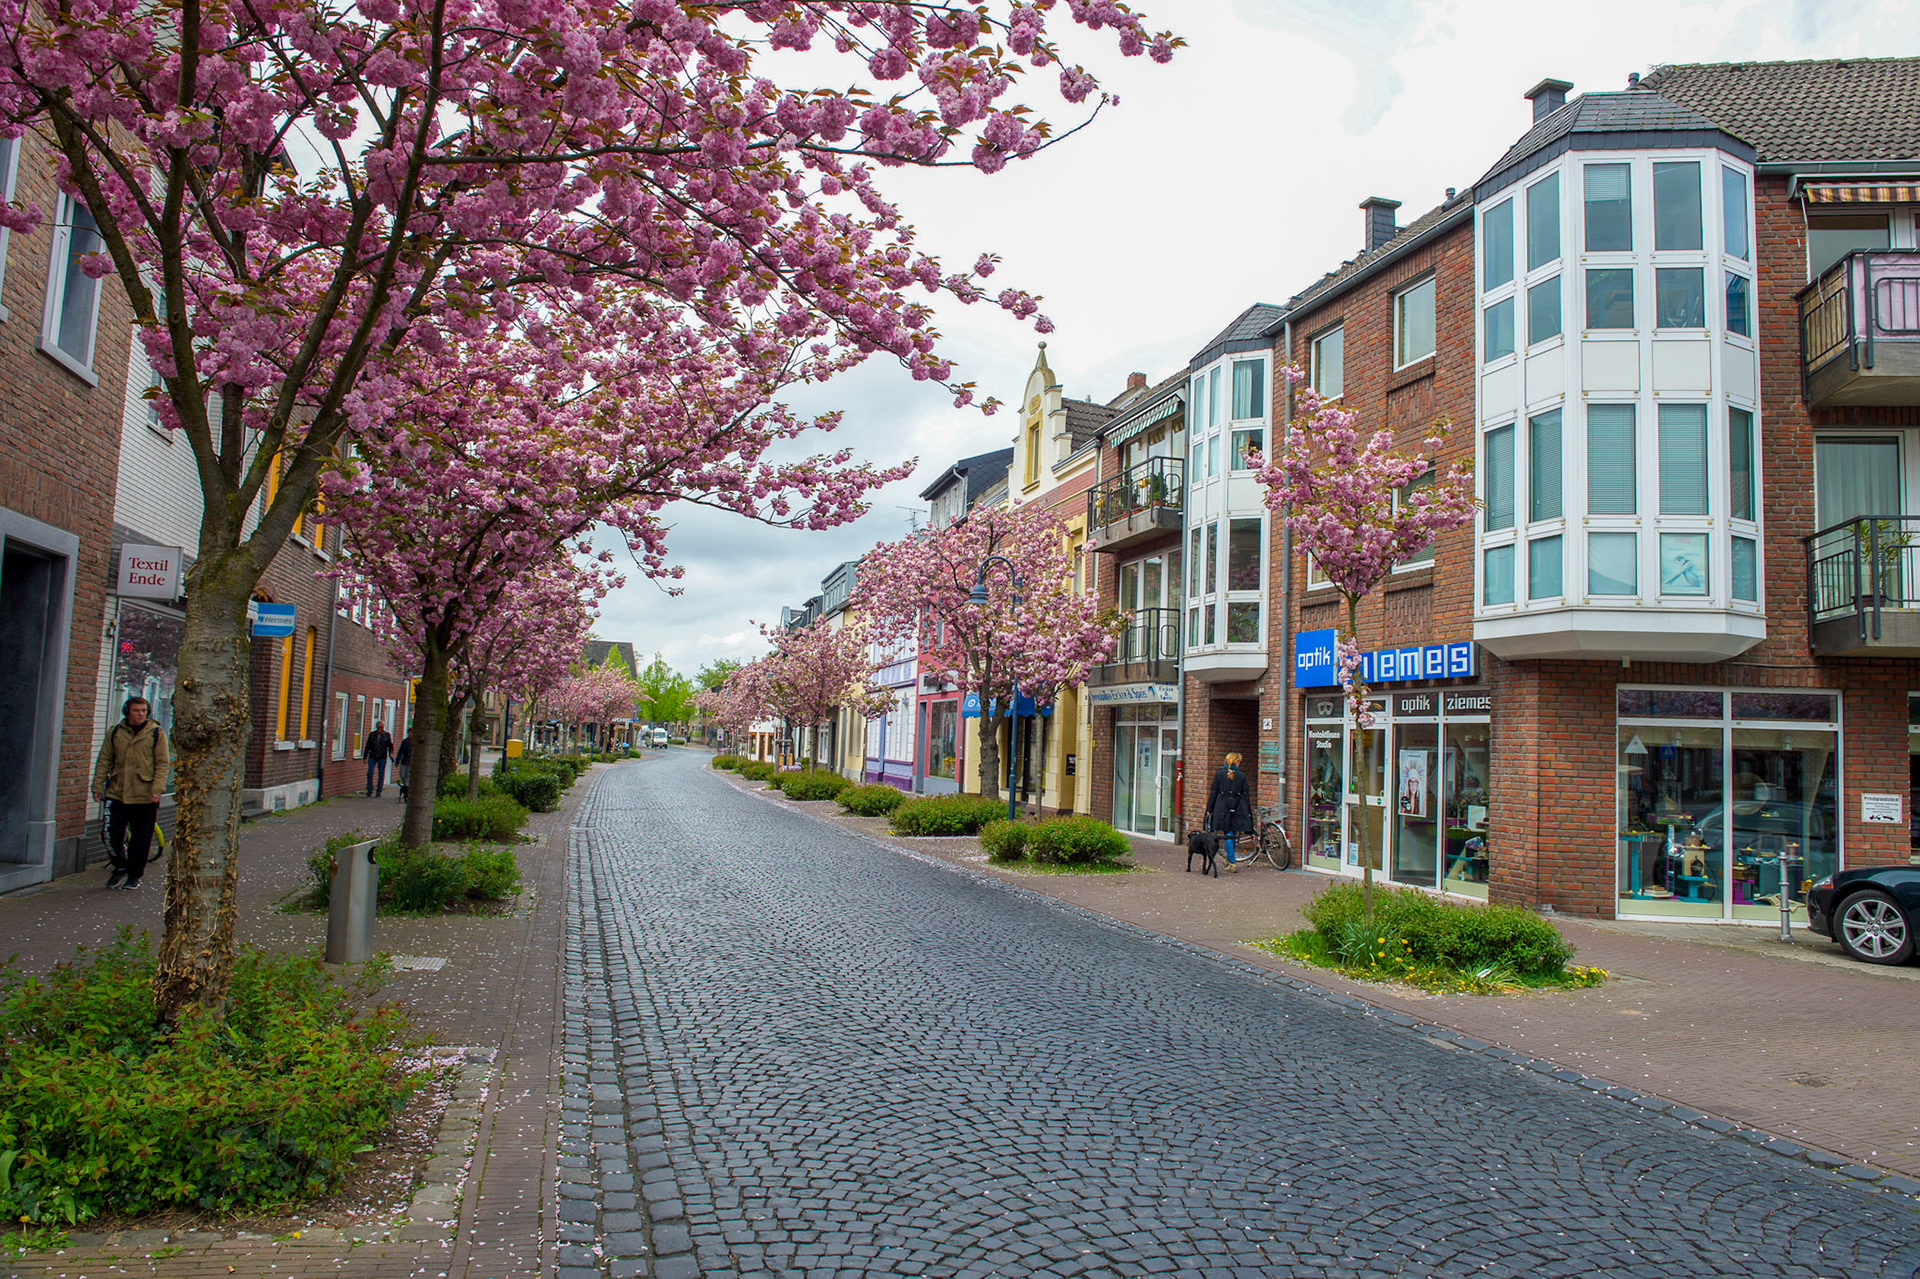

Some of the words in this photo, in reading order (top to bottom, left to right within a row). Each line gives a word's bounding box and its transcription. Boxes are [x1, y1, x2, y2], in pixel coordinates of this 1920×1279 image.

[128, 557, 169, 571] Textil
[128, 571, 166, 586] Ende
[264, 616, 293, 625] Hermes
[1297, 646, 1331, 671] optik
[1401, 694, 1431, 714] optik
